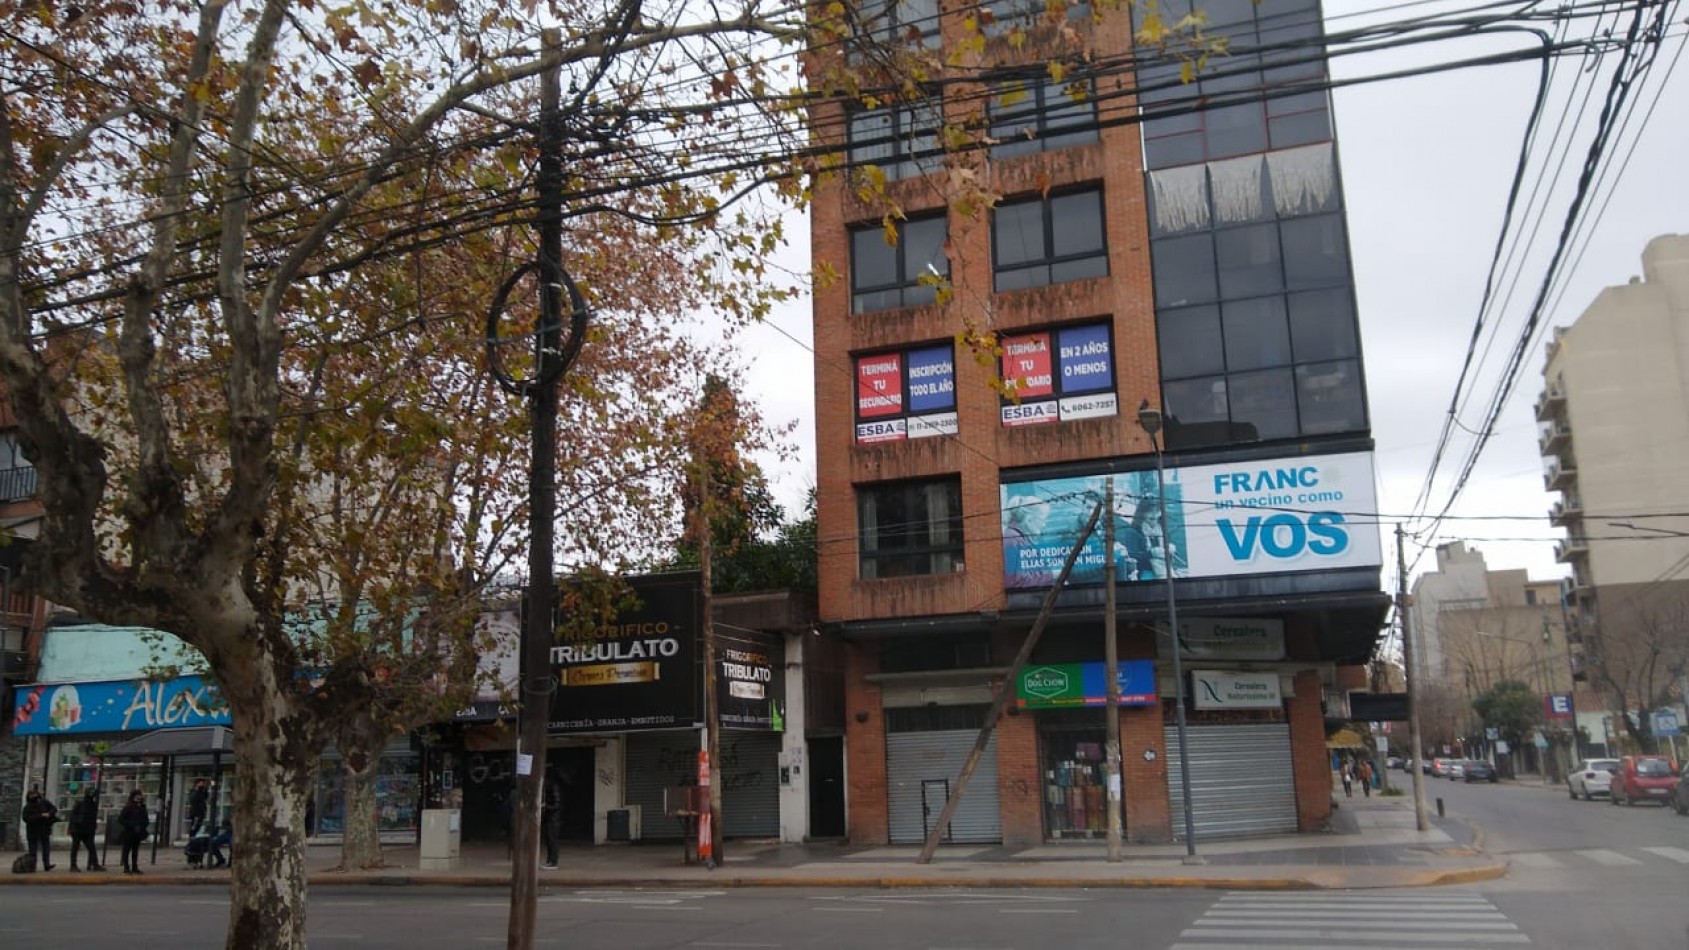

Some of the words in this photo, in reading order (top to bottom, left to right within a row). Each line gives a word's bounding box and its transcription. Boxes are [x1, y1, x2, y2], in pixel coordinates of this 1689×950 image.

[1060, 346, 1073, 358] EN
[1074, 345, 1081, 357] 2
[1081, 341, 1108, 355] AÑOS
[861, 359, 898, 377] TERMINÁ
[909, 360, 953, 378] INSCRIPCIÓN
[1020, 360, 1034, 371] TU
[1064, 366, 1072, 376] O
[1073, 361, 1107, 376] MENOS
[873, 379, 886, 390] TU
[910, 384, 928, 397] TODO
[929, 382, 938, 394] EL
[938, 378, 954, 392] AÑO
[859, 393, 902, 409] SECUNDARIO
[1003, 405, 1045, 419] ESBA
[857, 422, 895, 437] ESBA
[1214, 499, 1234, 510] un
[1239, 493, 1293, 508] vecino
[1297, 490, 1344, 504] como
[1215, 511, 1349, 561] VOS
[1020, 548, 1037, 559] POR
[1020, 559, 1045, 570] ELLAS
[1046, 556, 1065, 568] SON
[549, 637, 680, 664] TRIBULATO
[722, 662, 772, 682] TRIBULATO
[1027, 678, 1042, 687] DOG
[1043, 678, 1065, 687] CHOW
[1552, 696, 1569, 712] E
